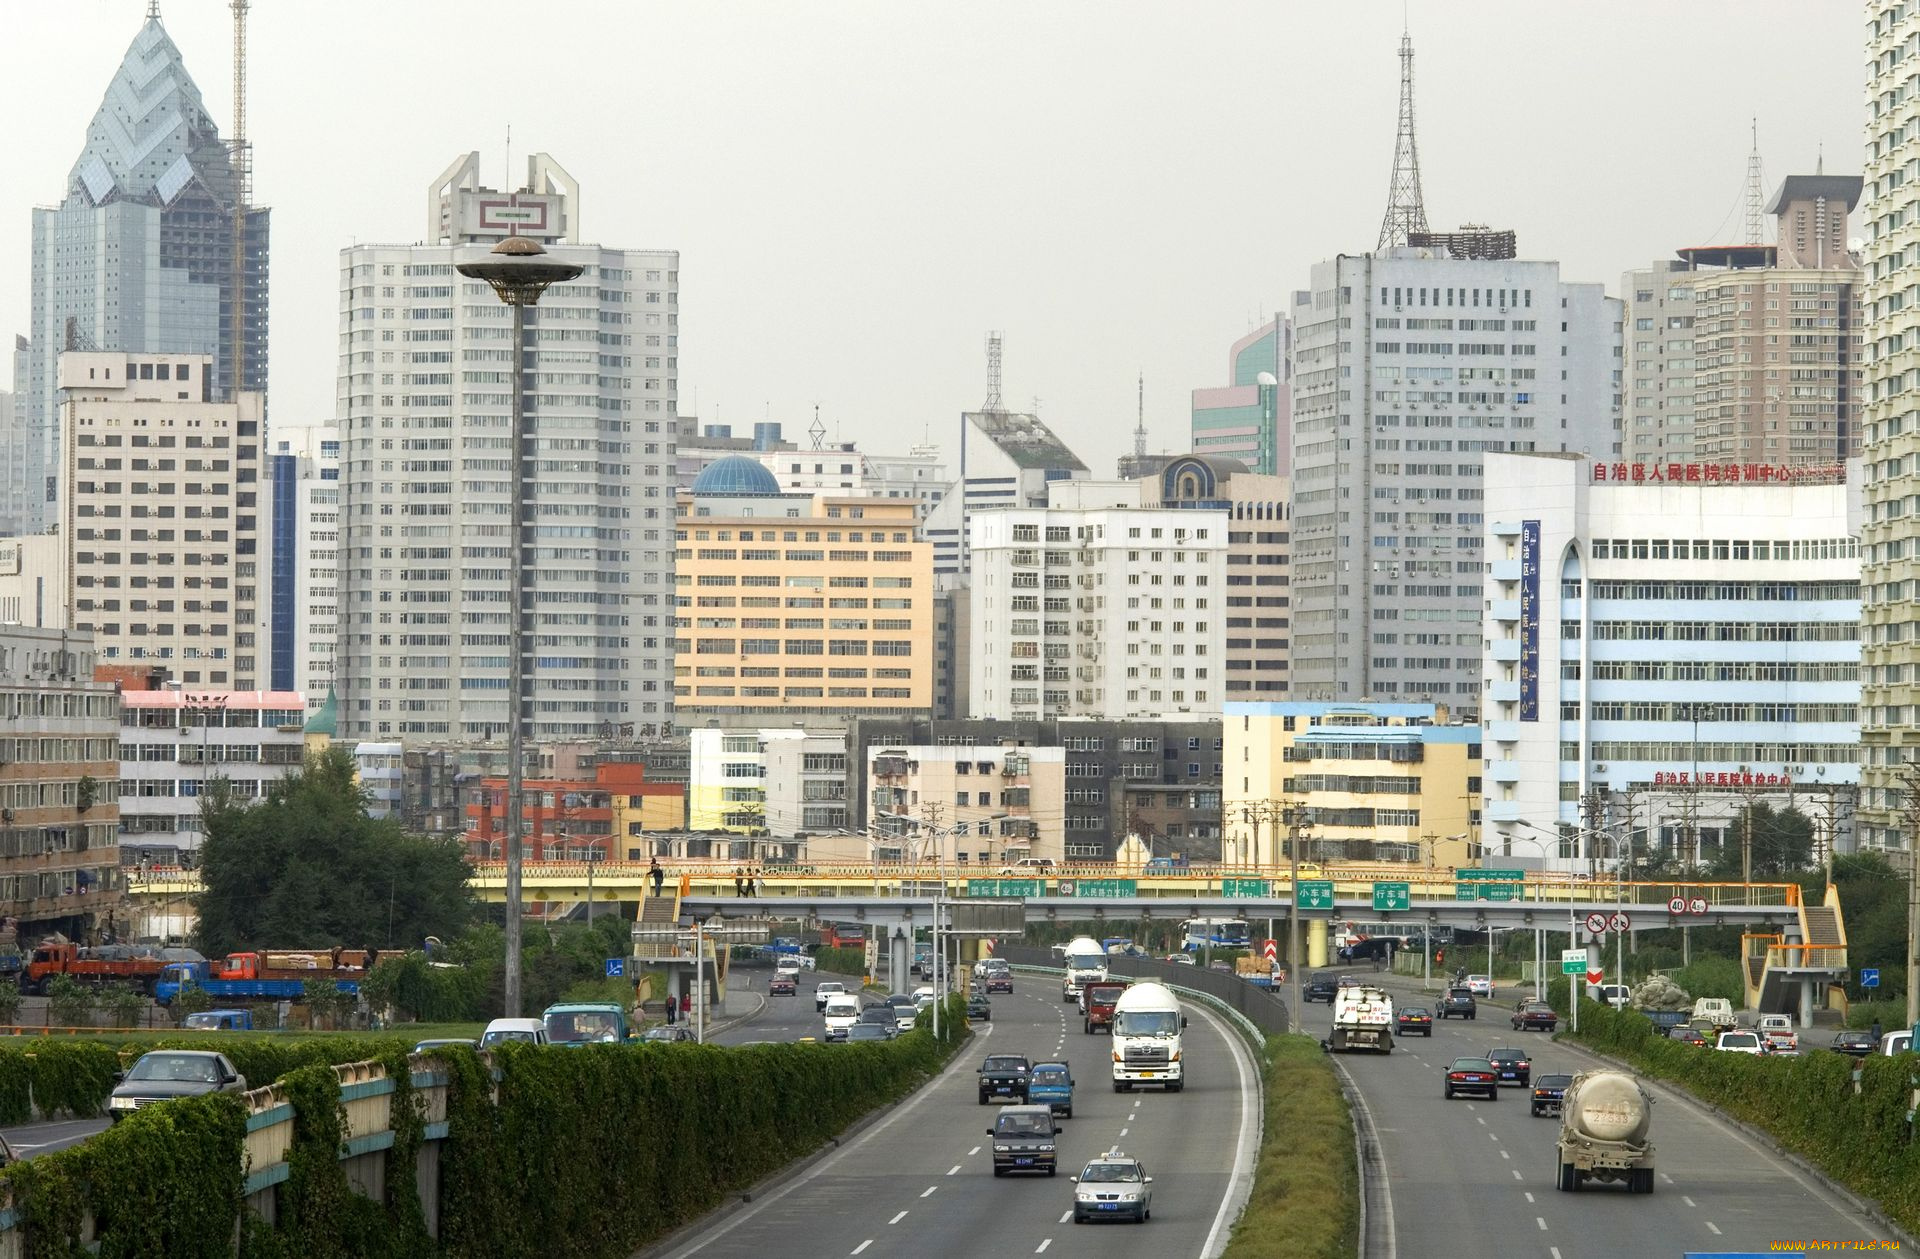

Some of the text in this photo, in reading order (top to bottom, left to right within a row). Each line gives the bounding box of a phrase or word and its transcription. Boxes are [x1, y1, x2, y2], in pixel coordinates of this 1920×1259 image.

[1594, 463, 1791, 481] 自治区人民医院培训中心
[1655, 771, 1791, 787] 自治区人民医院体检中心
[1300, 889, 1331, 898] 小车道
[1376, 890, 1407, 899] 行车道
[1672, 901, 1683, 911] 40
